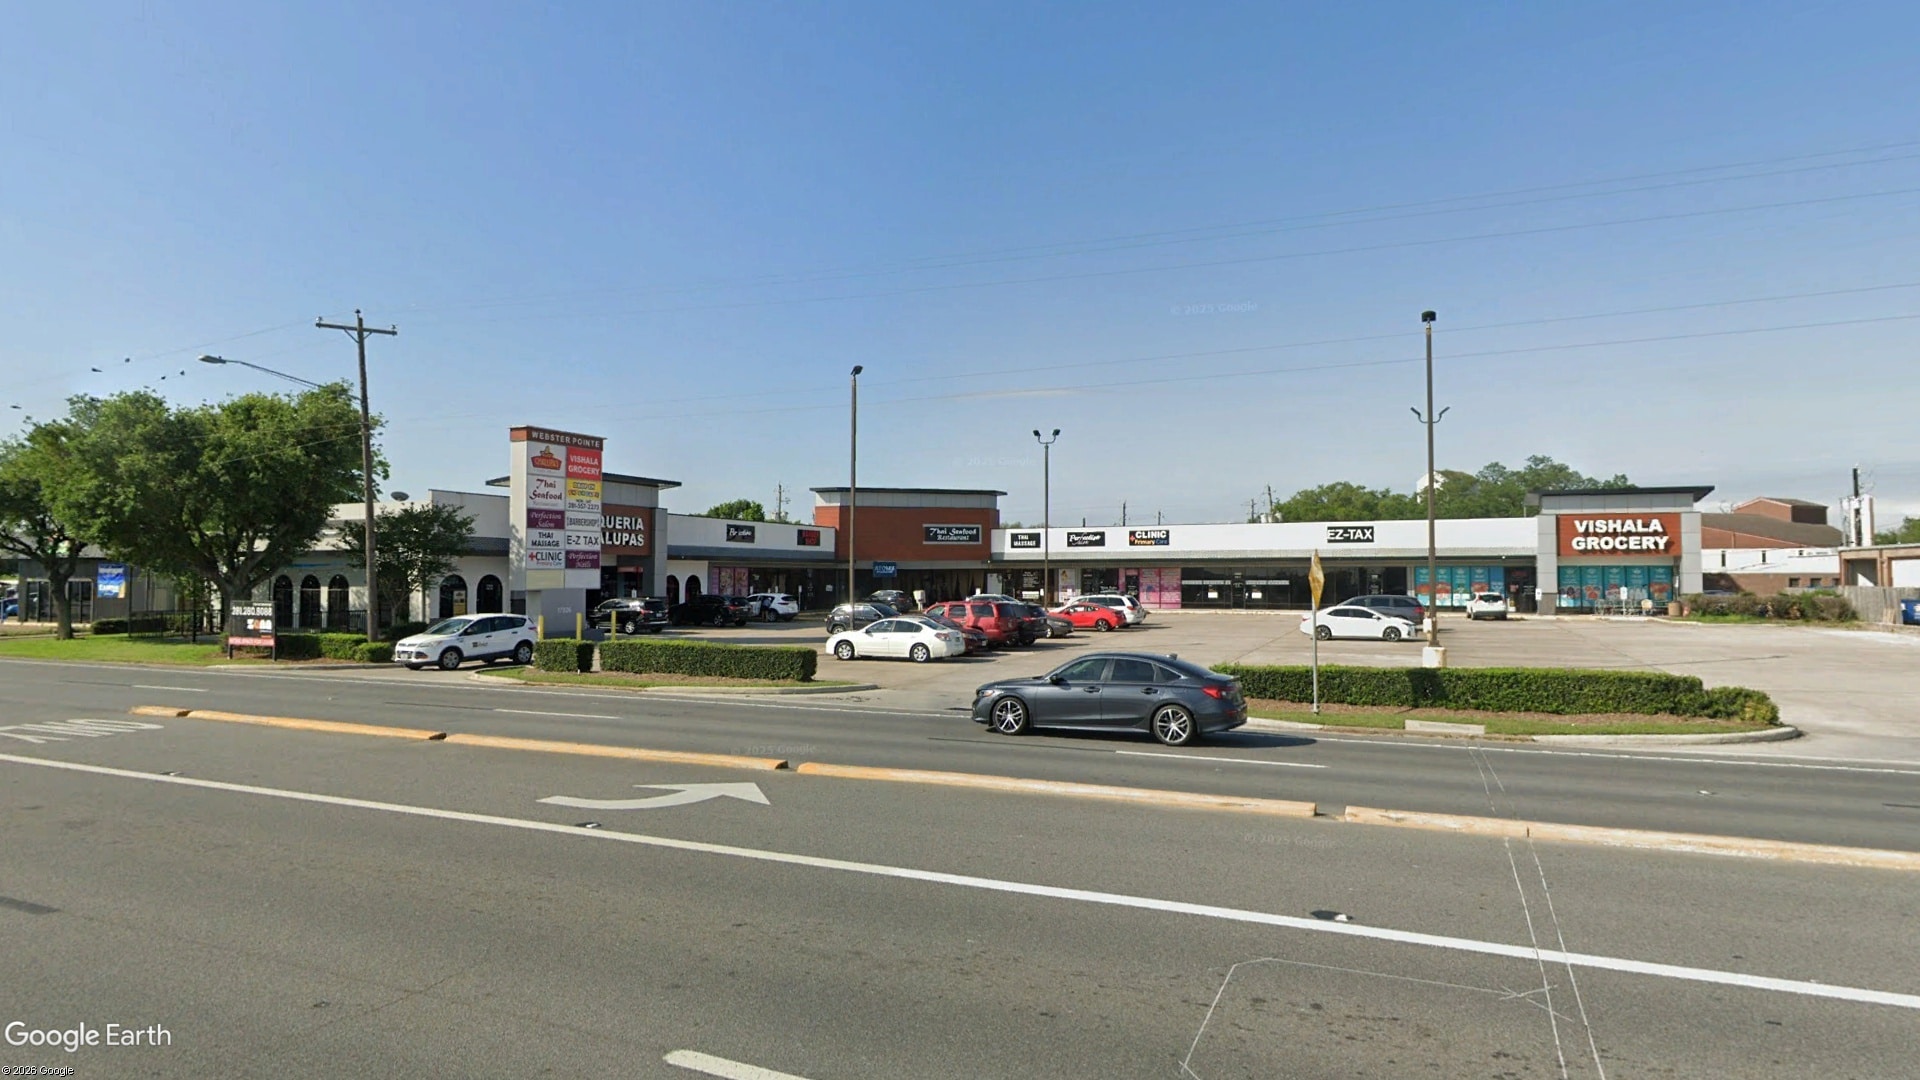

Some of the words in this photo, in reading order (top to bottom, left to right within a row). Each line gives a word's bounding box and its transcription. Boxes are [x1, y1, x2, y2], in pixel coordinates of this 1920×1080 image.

[531, 431, 571, 444] WEBSTER
[572, 439, 600, 448] POINTE
[569, 454, 599, 466] VISHALA
[568, 465, 600, 476] GROCERY
[536, 478, 556, 489] Thai
[529, 489, 563, 500] Seafood
[929, 527, 947, 536] Thai
[949, 527, 977, 536] Seafood
[1574, 519, 1663, 533] VISHALA
[1135, 531, 1167, 539] CLINIC
[1327, 528, 1373, 540] EZ-TAX
[531, 539, 560, 547] MASSAGE
[566, 535, 581, 545] E-Z
[583, 535, 599, 545] TAX
[1571, 536, 1669, 550] GROCERY
[535, 551, 563, 561] CLINIC
